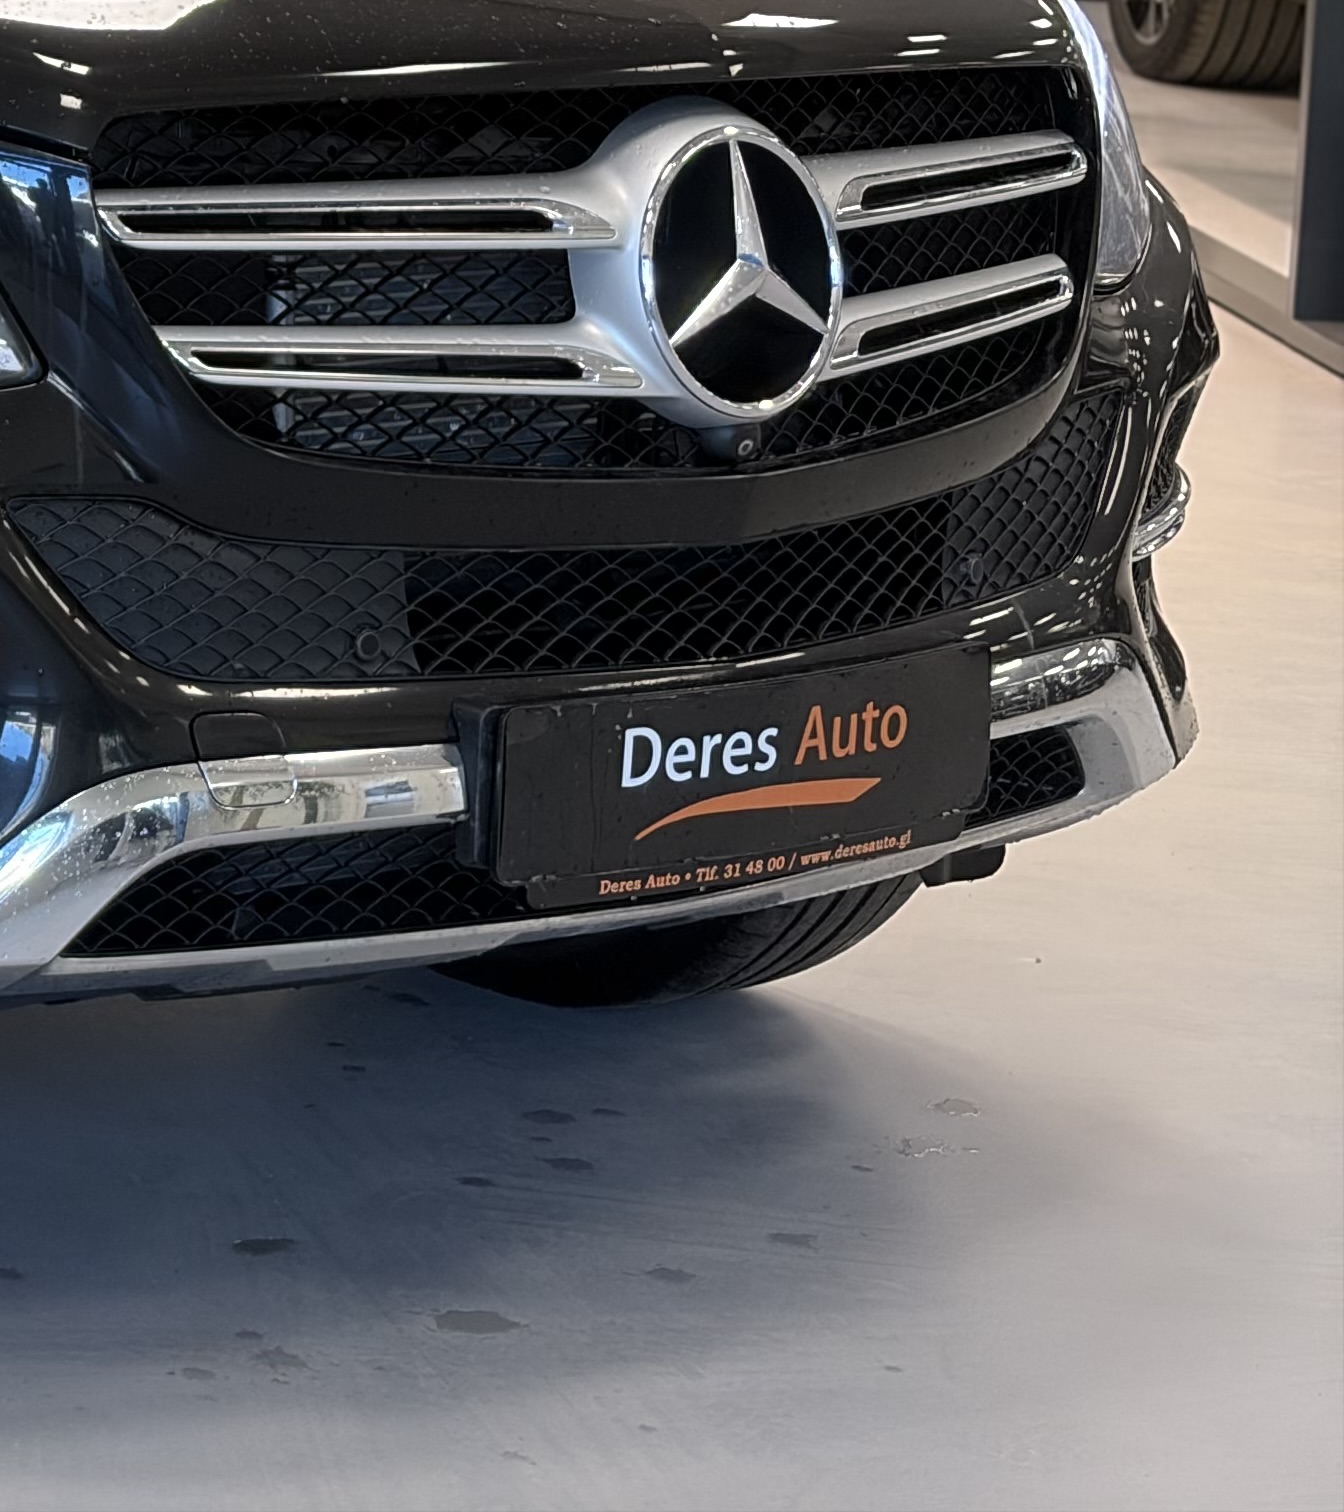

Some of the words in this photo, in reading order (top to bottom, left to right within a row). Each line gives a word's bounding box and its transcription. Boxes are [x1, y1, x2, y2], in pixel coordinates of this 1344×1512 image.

[620, 726, 779, 788] Deres
[794, 700, 908, 766] Auto
[598, 879, 642, 896] Deres
[644, 873, 680, 889] Auto
[695, 865, 719, 883] Tlf.
[723, 862, 741, 879] 31
[745, 857, 764, 875] 48
[767, 855, 786, 873] 00
[800, 829, 912, 866] www.deresauto.gl
